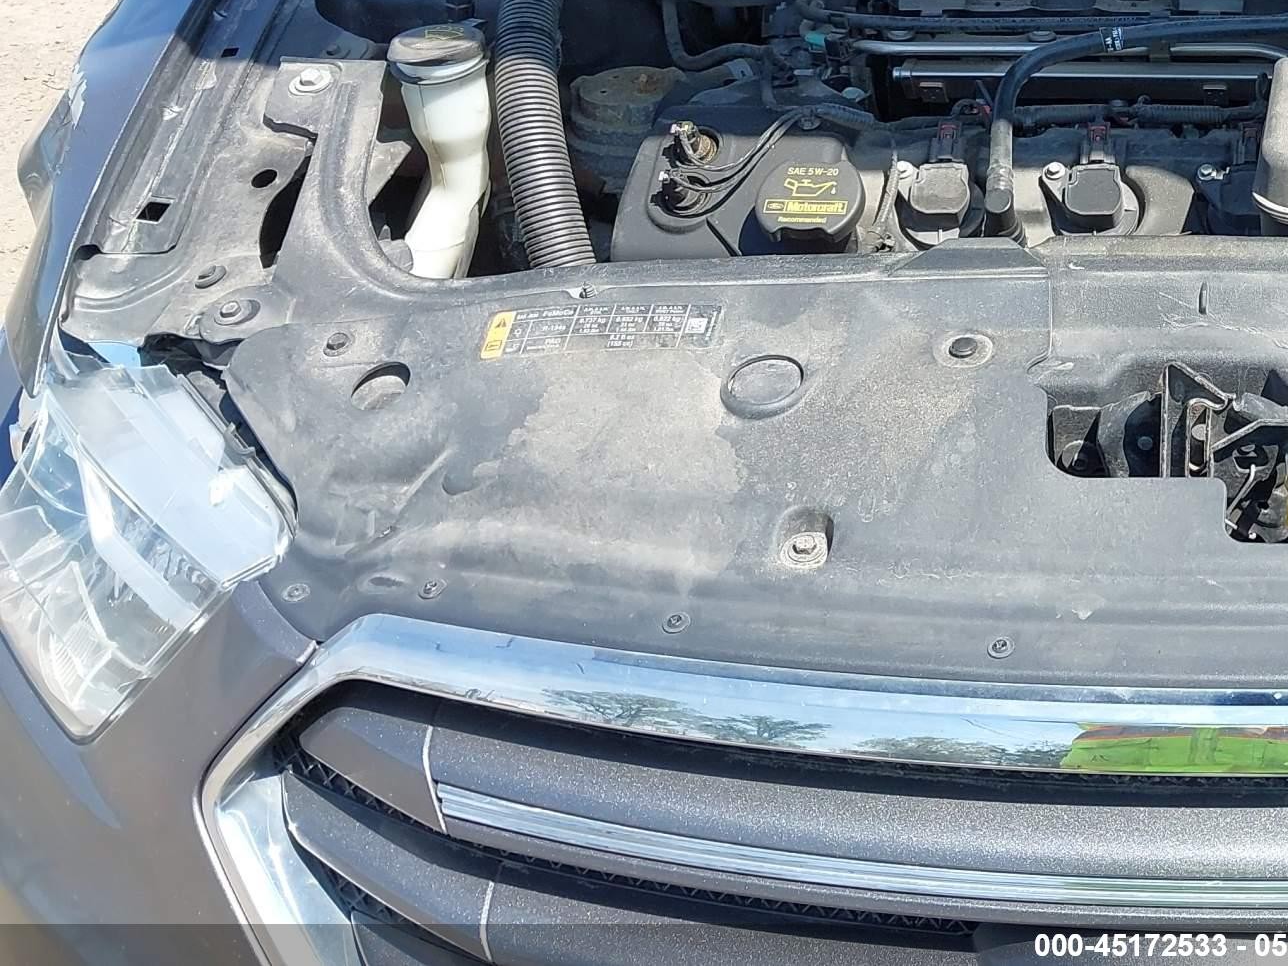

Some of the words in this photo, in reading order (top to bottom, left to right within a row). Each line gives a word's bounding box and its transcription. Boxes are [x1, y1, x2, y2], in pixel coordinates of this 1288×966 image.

[787, 167, 806, 175] SAE
[807, 167, 839, 176] 5W-20
[787, 201, 841, 213] Motorcraft
[777, 216, 828, 224] Recommended
